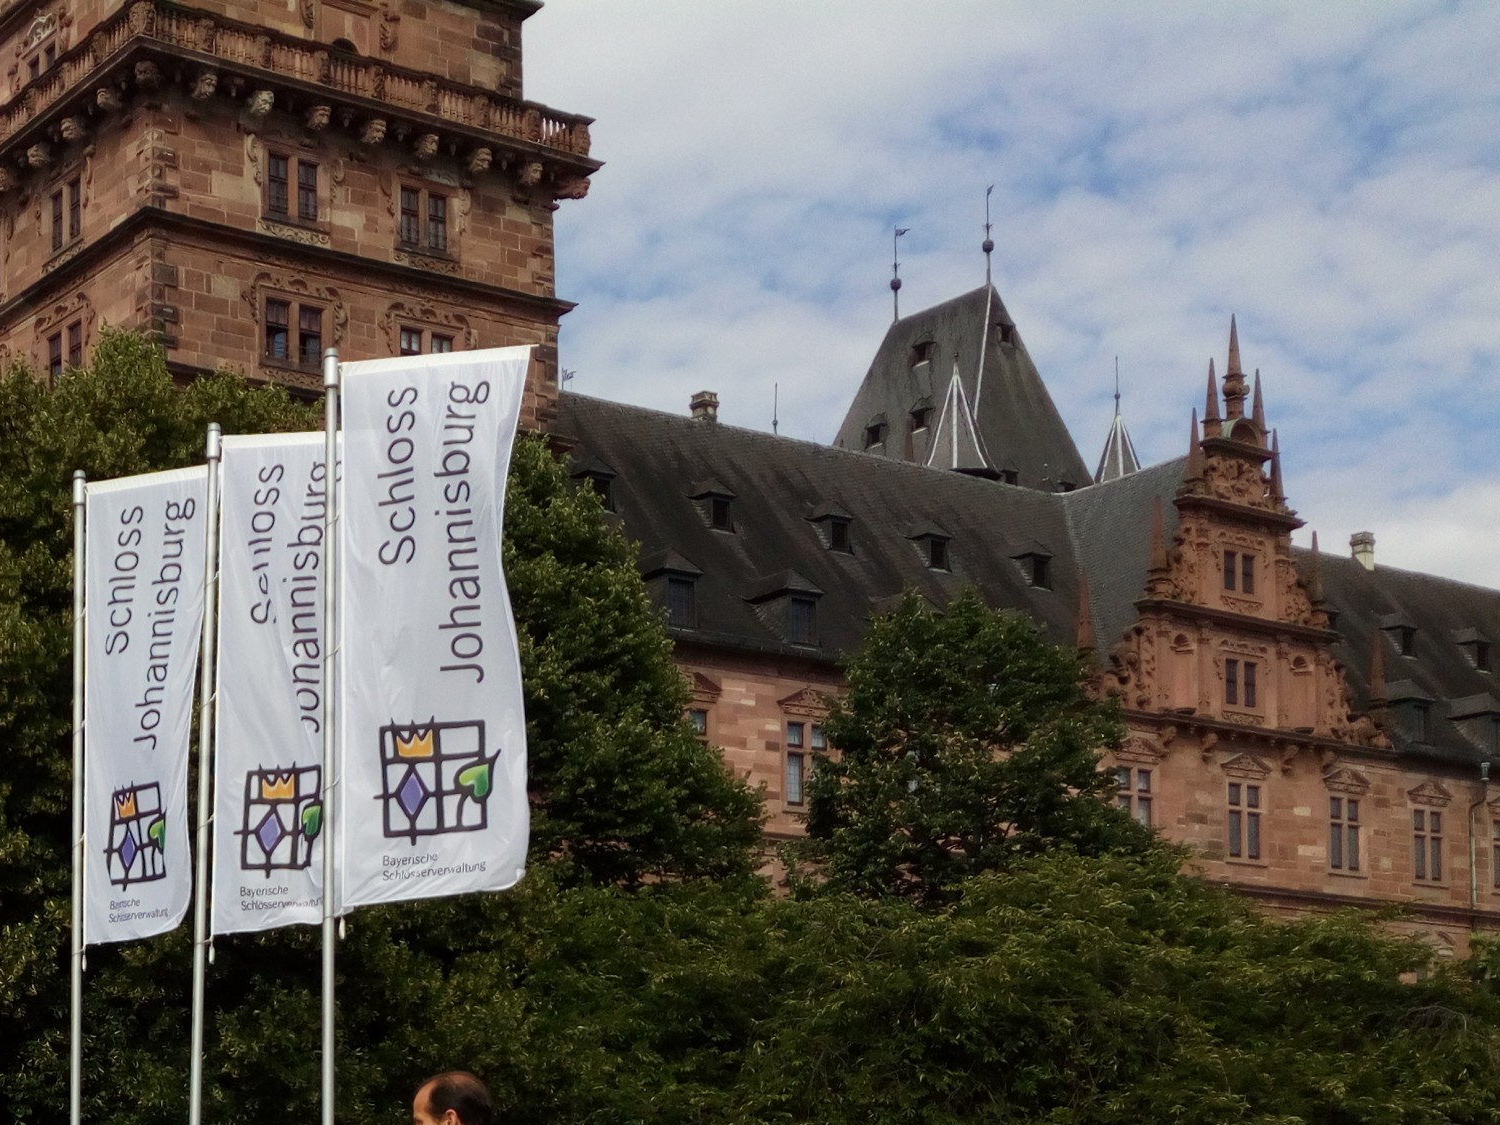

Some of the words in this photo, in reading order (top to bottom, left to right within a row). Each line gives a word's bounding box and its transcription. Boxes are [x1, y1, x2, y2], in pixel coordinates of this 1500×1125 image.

[376, 386, 419, 566] Schloss
[433, 379, 491, 684] Johannisburg
[105, 505, 143, 655] Schloss
[133, 497, 196, 750] Johannisburg
[240, 885, 289, 898] Bayerische
[382, 853, 438, 868] Bayerische
